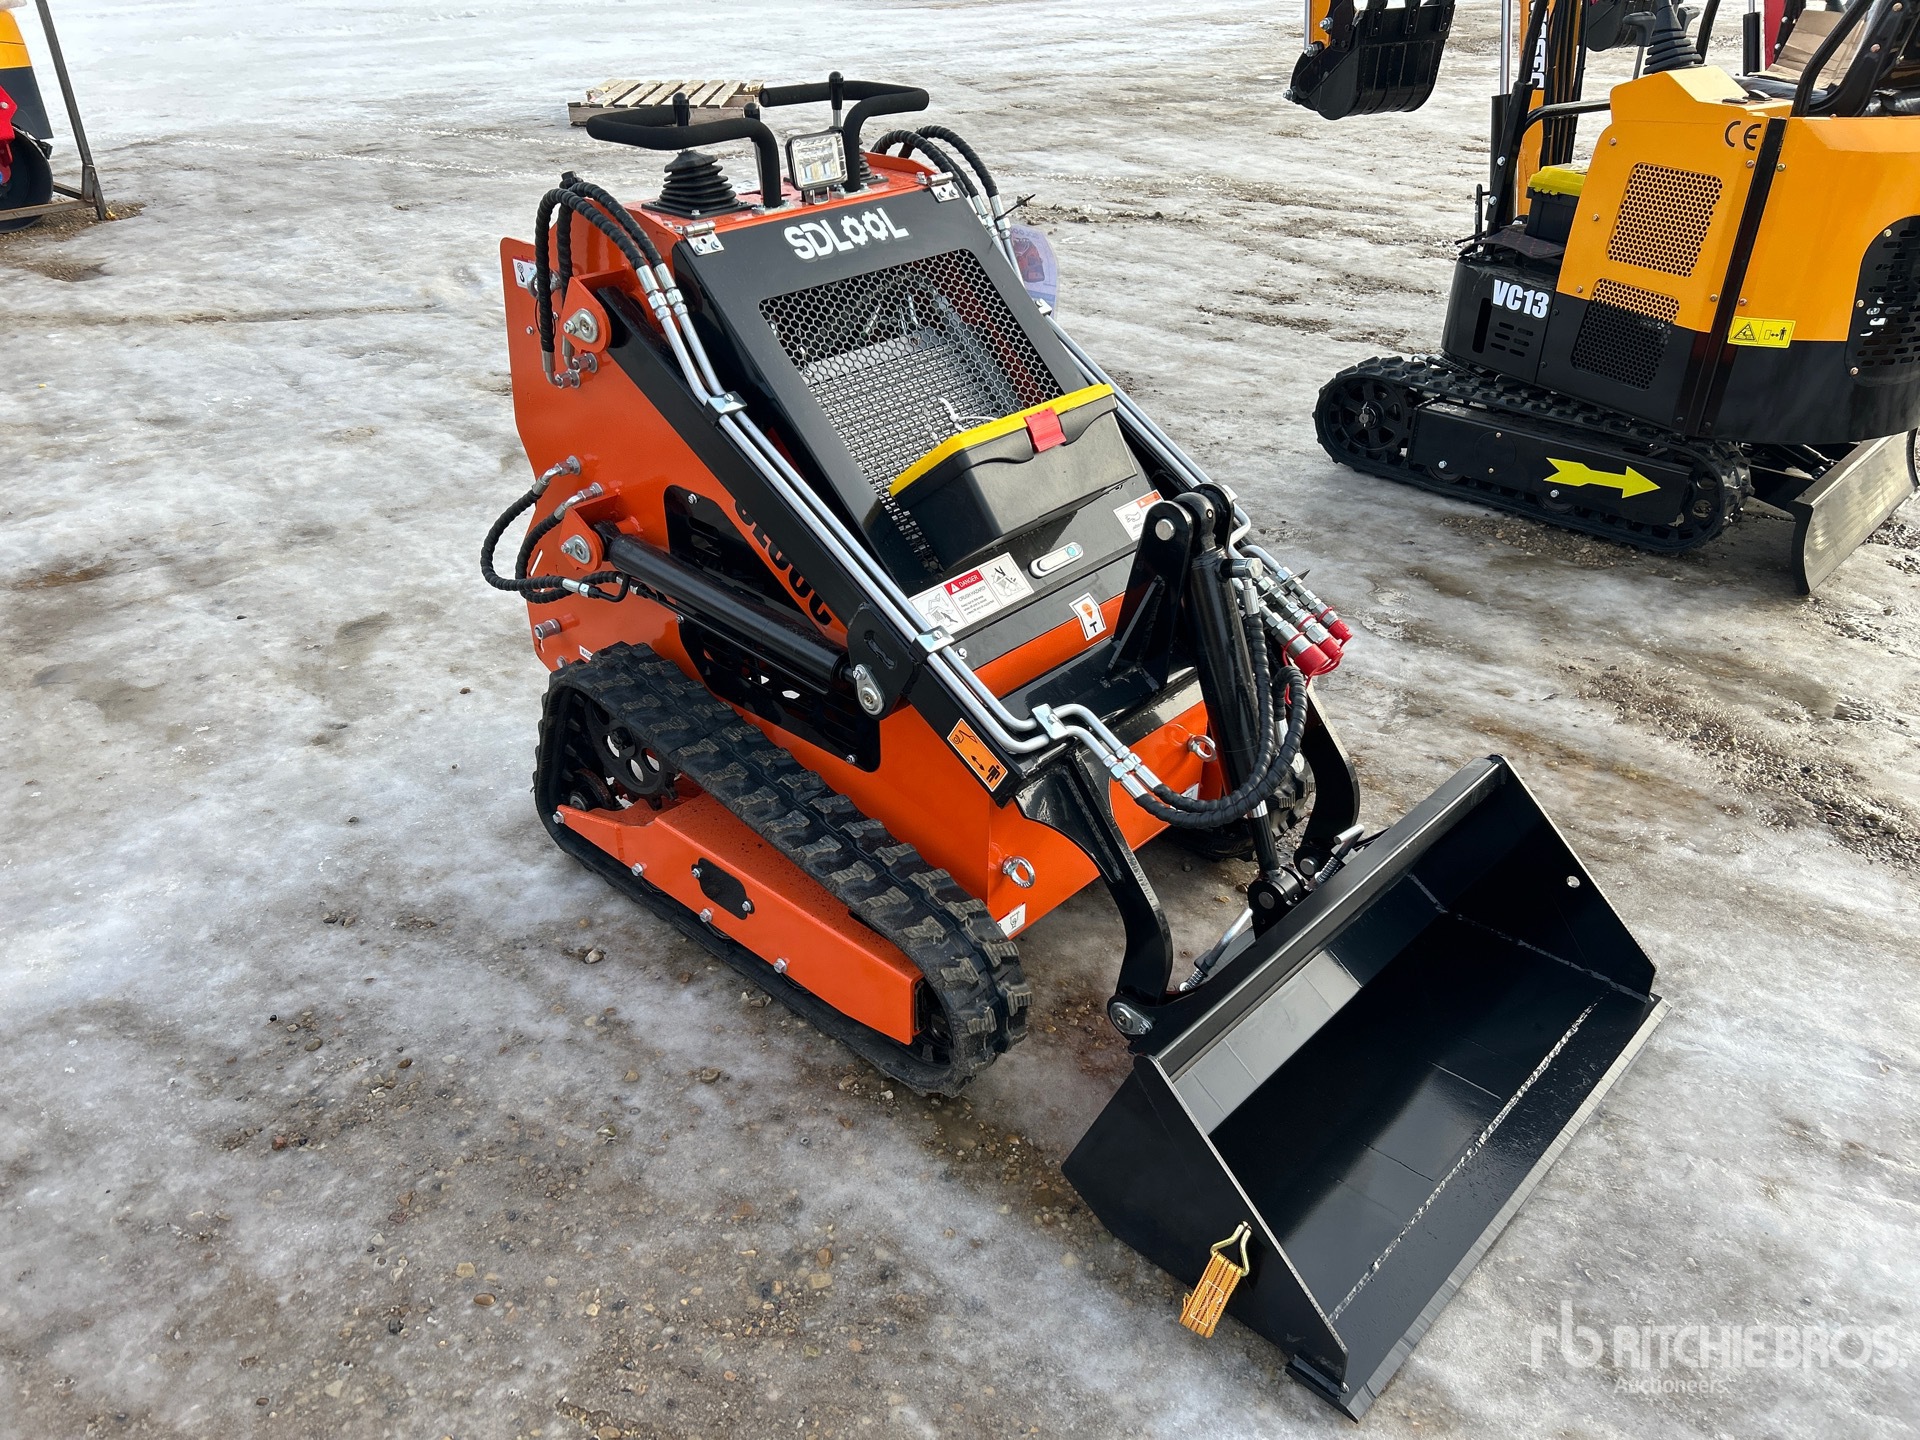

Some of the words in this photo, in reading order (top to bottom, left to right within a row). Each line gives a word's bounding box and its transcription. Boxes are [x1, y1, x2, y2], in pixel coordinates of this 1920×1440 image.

[783, 207, 910, 260] SDLOOL
[1492, 279, 1550, 318] VC13
[959, 574, 979, 588] DANGER
